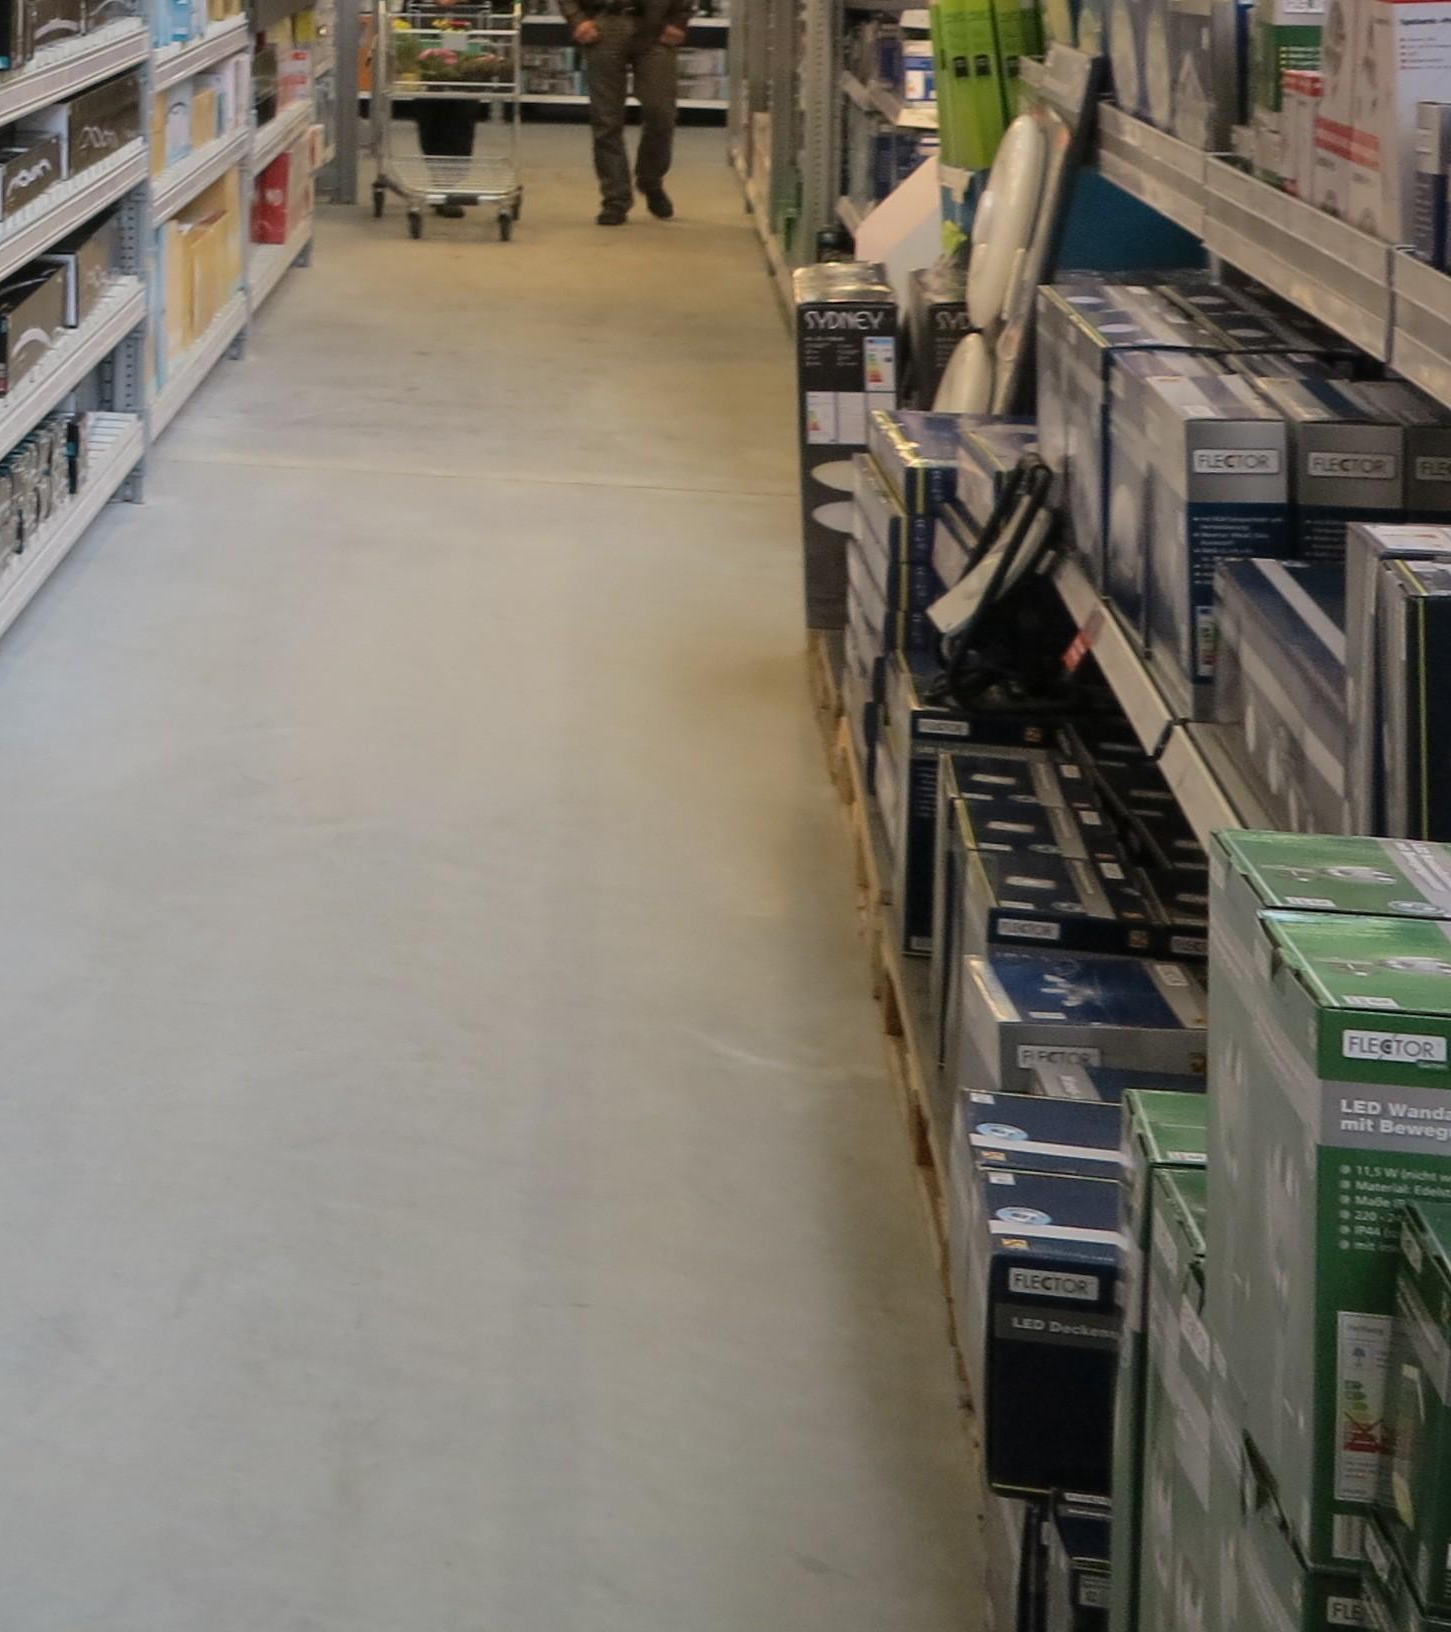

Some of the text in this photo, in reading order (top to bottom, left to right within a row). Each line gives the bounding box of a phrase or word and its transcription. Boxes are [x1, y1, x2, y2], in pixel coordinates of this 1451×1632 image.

[804, 310, 885, 331] SYDNEY
[1198, 454, 1270, 469] FLECTOR
[1313, 458, 1388, 474] FLECTOR
[1348, 1035, 1435, 1059] FLECTOR
[1339, 1098, 1382, 1115] LED
[1340, 1117, 1375, 1134] mit
[1014, 1273, 1089, 1296] FLECTOR
[1012, 1317, 1045, 1331] LED
